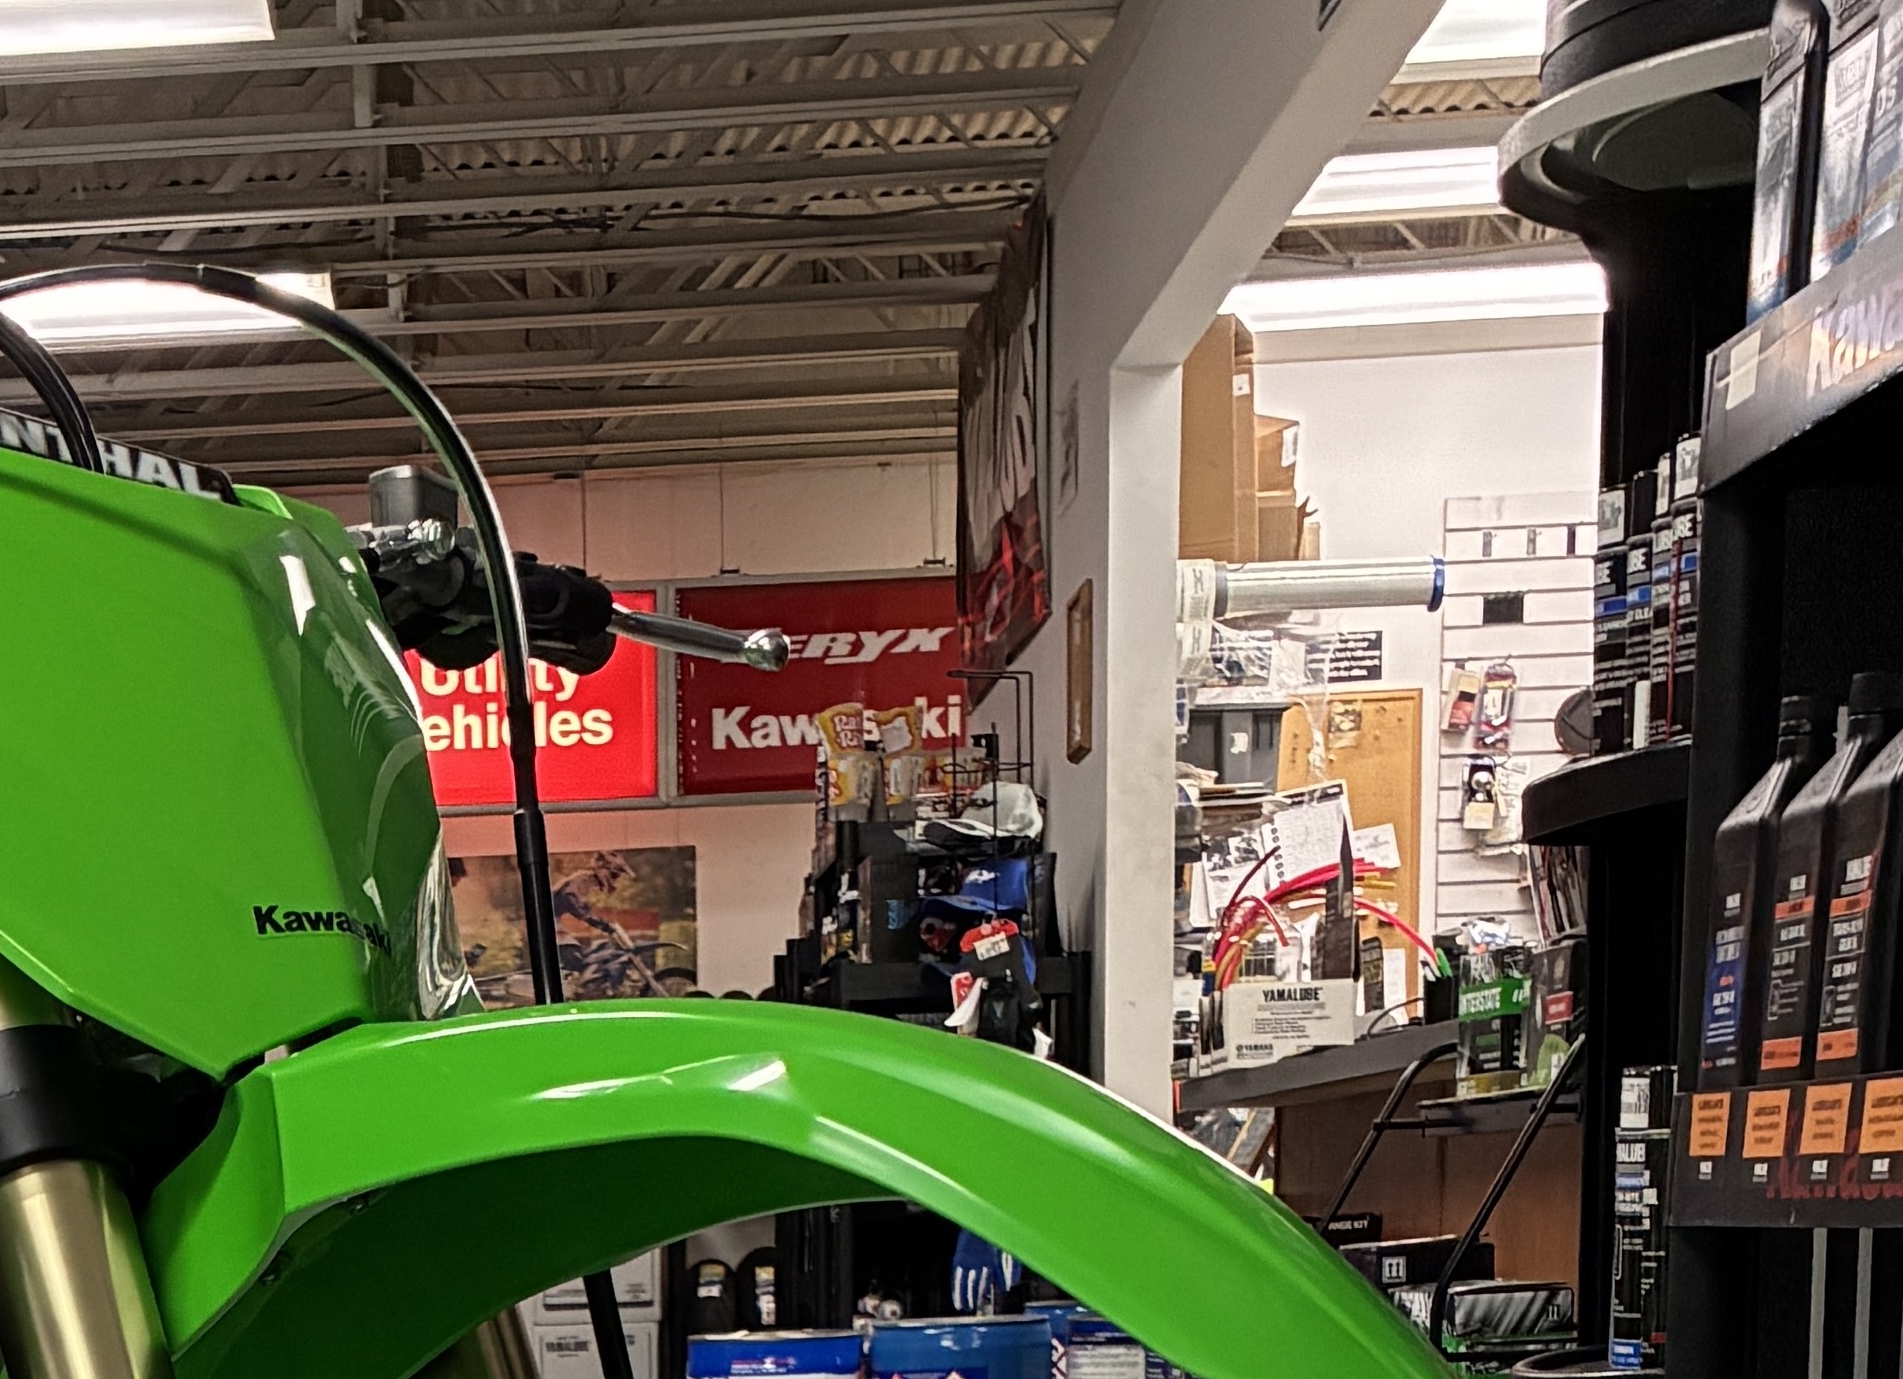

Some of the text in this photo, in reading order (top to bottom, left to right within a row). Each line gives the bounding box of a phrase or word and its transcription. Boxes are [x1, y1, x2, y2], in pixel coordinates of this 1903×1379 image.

[778, 626, 955, 665] ERYX
[422, 700, 614, 752] ehiles
[711, 694, 962, 750] Kawski
[1262, 987, 1321, 1003] YAMALUBE
